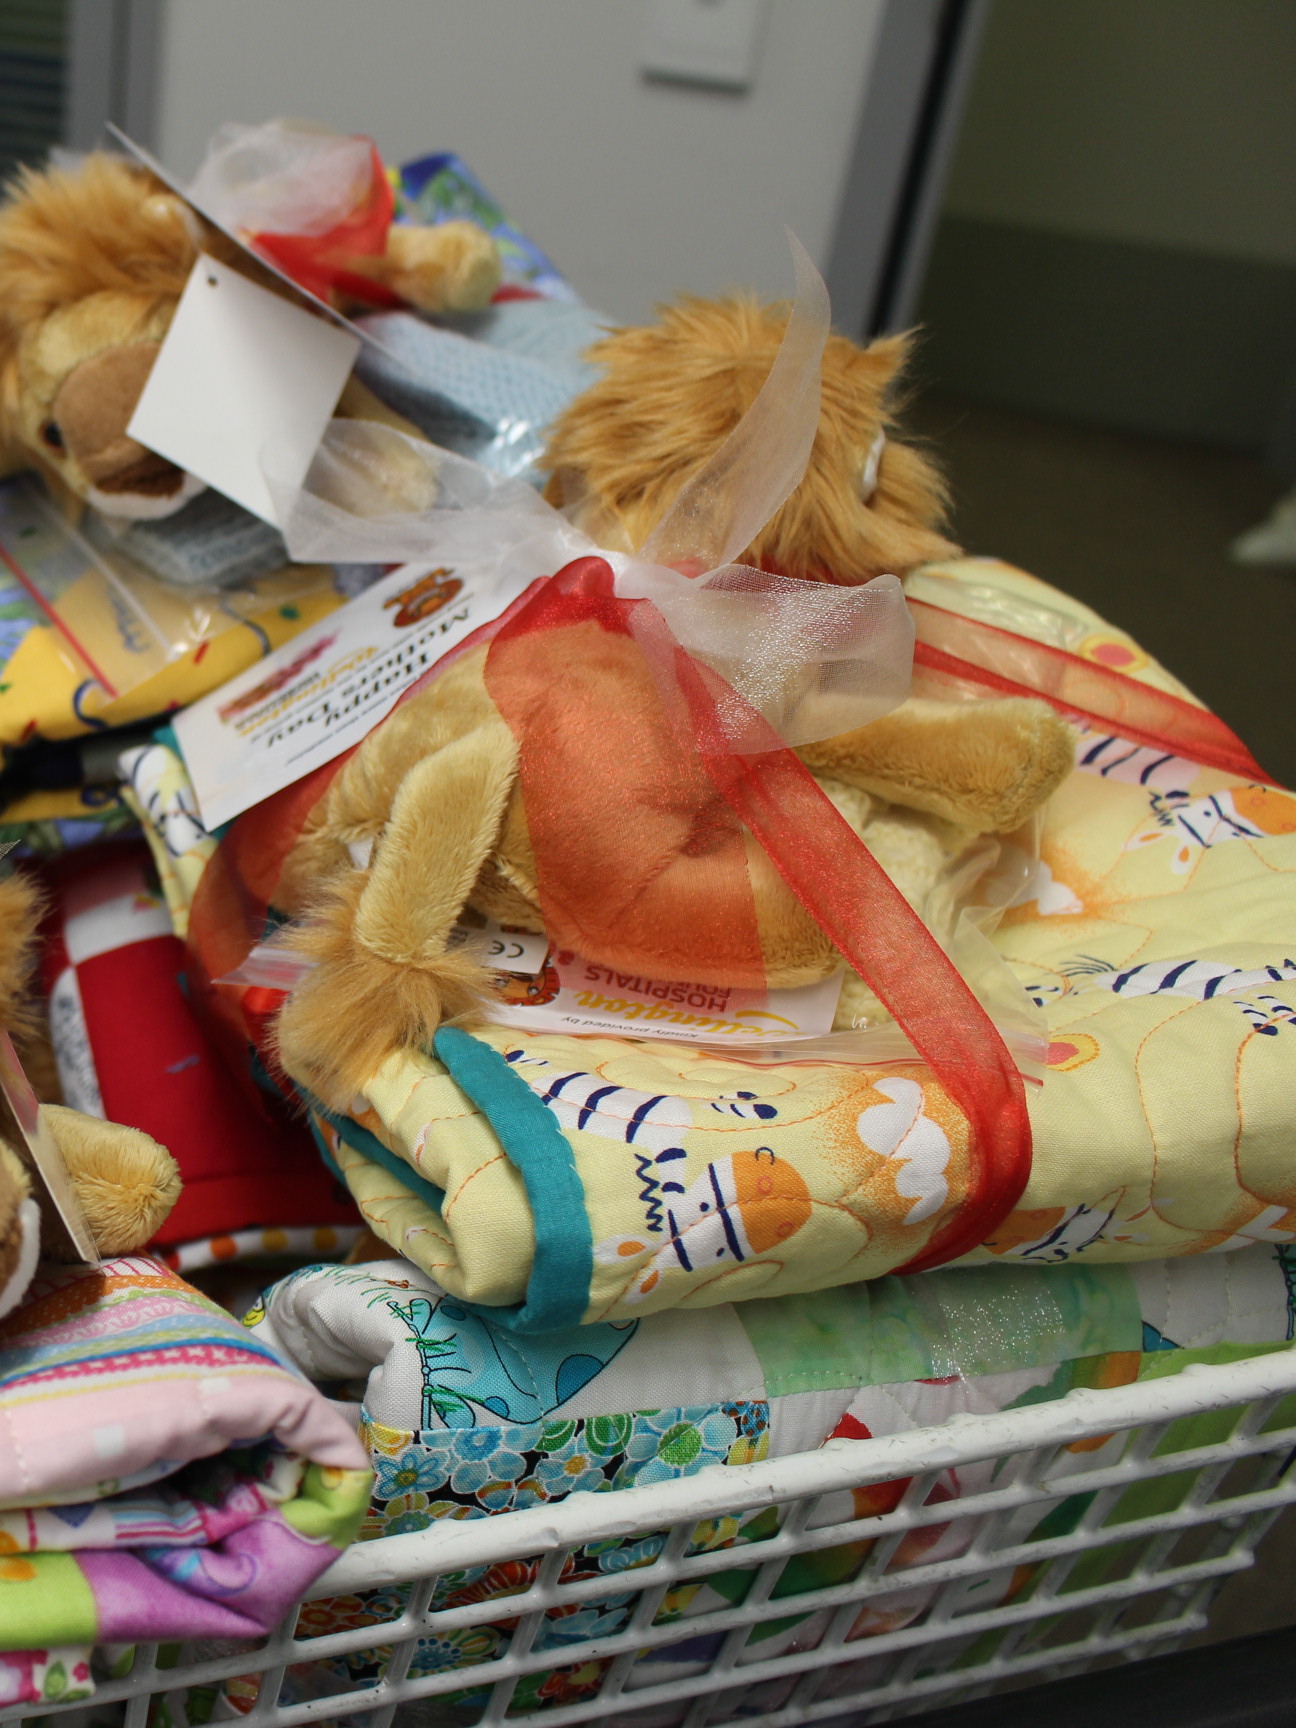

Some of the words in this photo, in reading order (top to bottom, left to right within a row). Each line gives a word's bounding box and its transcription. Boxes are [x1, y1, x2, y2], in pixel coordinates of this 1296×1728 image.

[342, 607, 471, 698] Mothers
[325, 652, 428, 727] Happy
[267, 702, 331, 748] Day
[584, 964, 728, 1013] HOSPITALS
[561, 1015, 579, 1024] by
[582, 1019, 650, 1034] provided
[653, 1029, 699, 1040] Kindly
